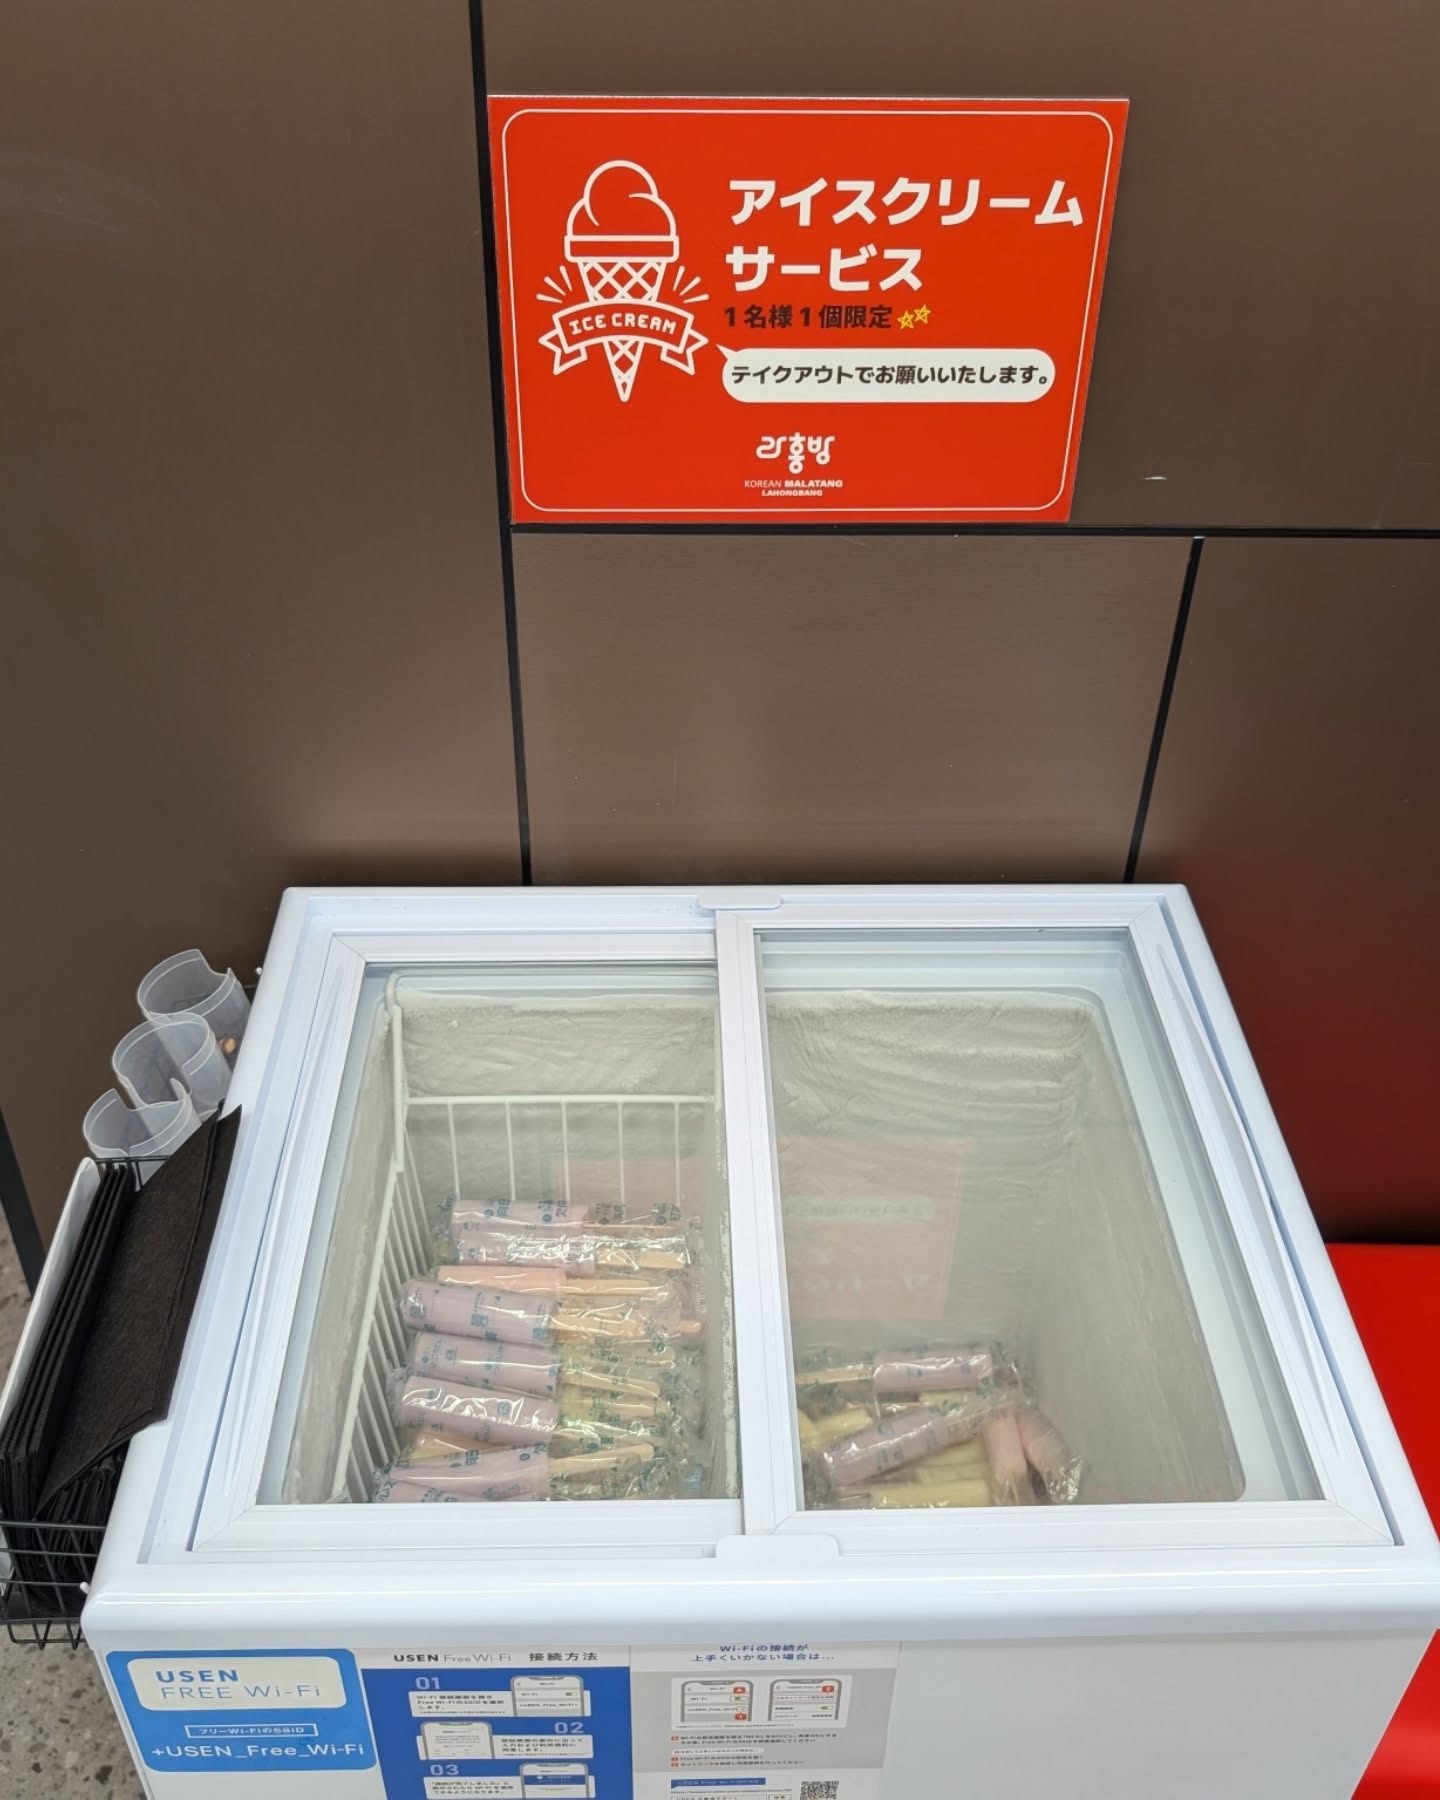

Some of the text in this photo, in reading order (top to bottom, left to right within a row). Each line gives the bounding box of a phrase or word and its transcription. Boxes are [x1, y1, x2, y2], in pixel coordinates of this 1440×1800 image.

[729, 177, 1084, 227] アイスクリーム
[725, 243, 923, 292] サービス
[568, 312, 677, 335] ICE CREAM
[731, 364, 1049, 386] テイクアウトでお願いいたします。
[744, 480, 843, 488] KOREAN MALATANG
[394, 1653, 512, 1662] USEN Free Wi-Fi
[528, 1651, 600, 1662] 接続方法
[156, 1669, 239, 1683] USEN
[415, 1676, 440, 1690] 01
[160, 1684, 321, 1700] FREE Wi-Fi
[554, 1721, 585, 1734] 02
[429, 1764, 460, 1776] 03
